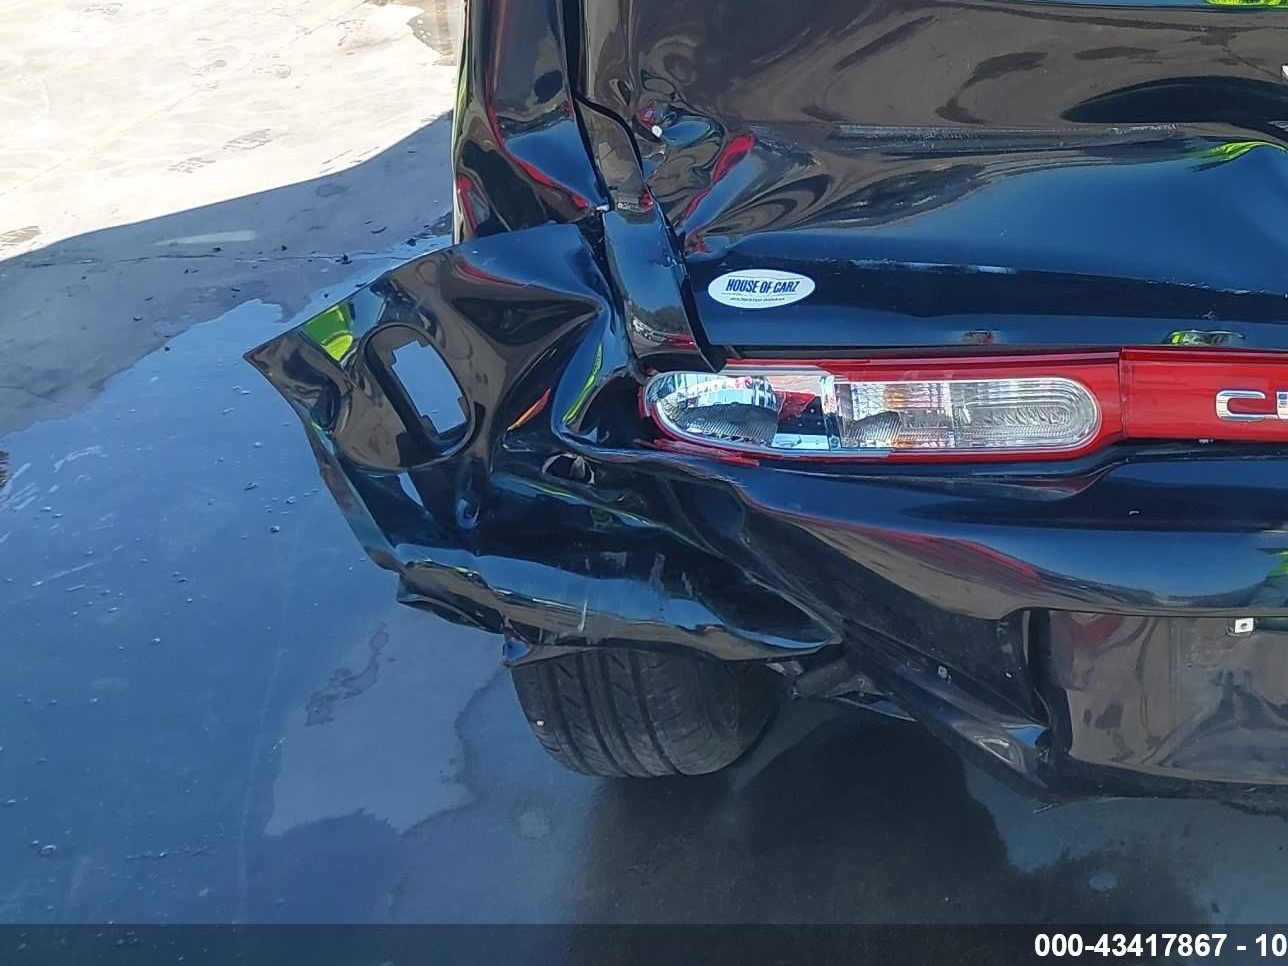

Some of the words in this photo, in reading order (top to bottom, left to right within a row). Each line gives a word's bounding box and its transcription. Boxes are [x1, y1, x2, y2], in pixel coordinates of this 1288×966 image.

[726, 278, 760, 293] HOUSE
[759, 281, 773, 294] OF
[773, 280, 801, 293] CARZ
